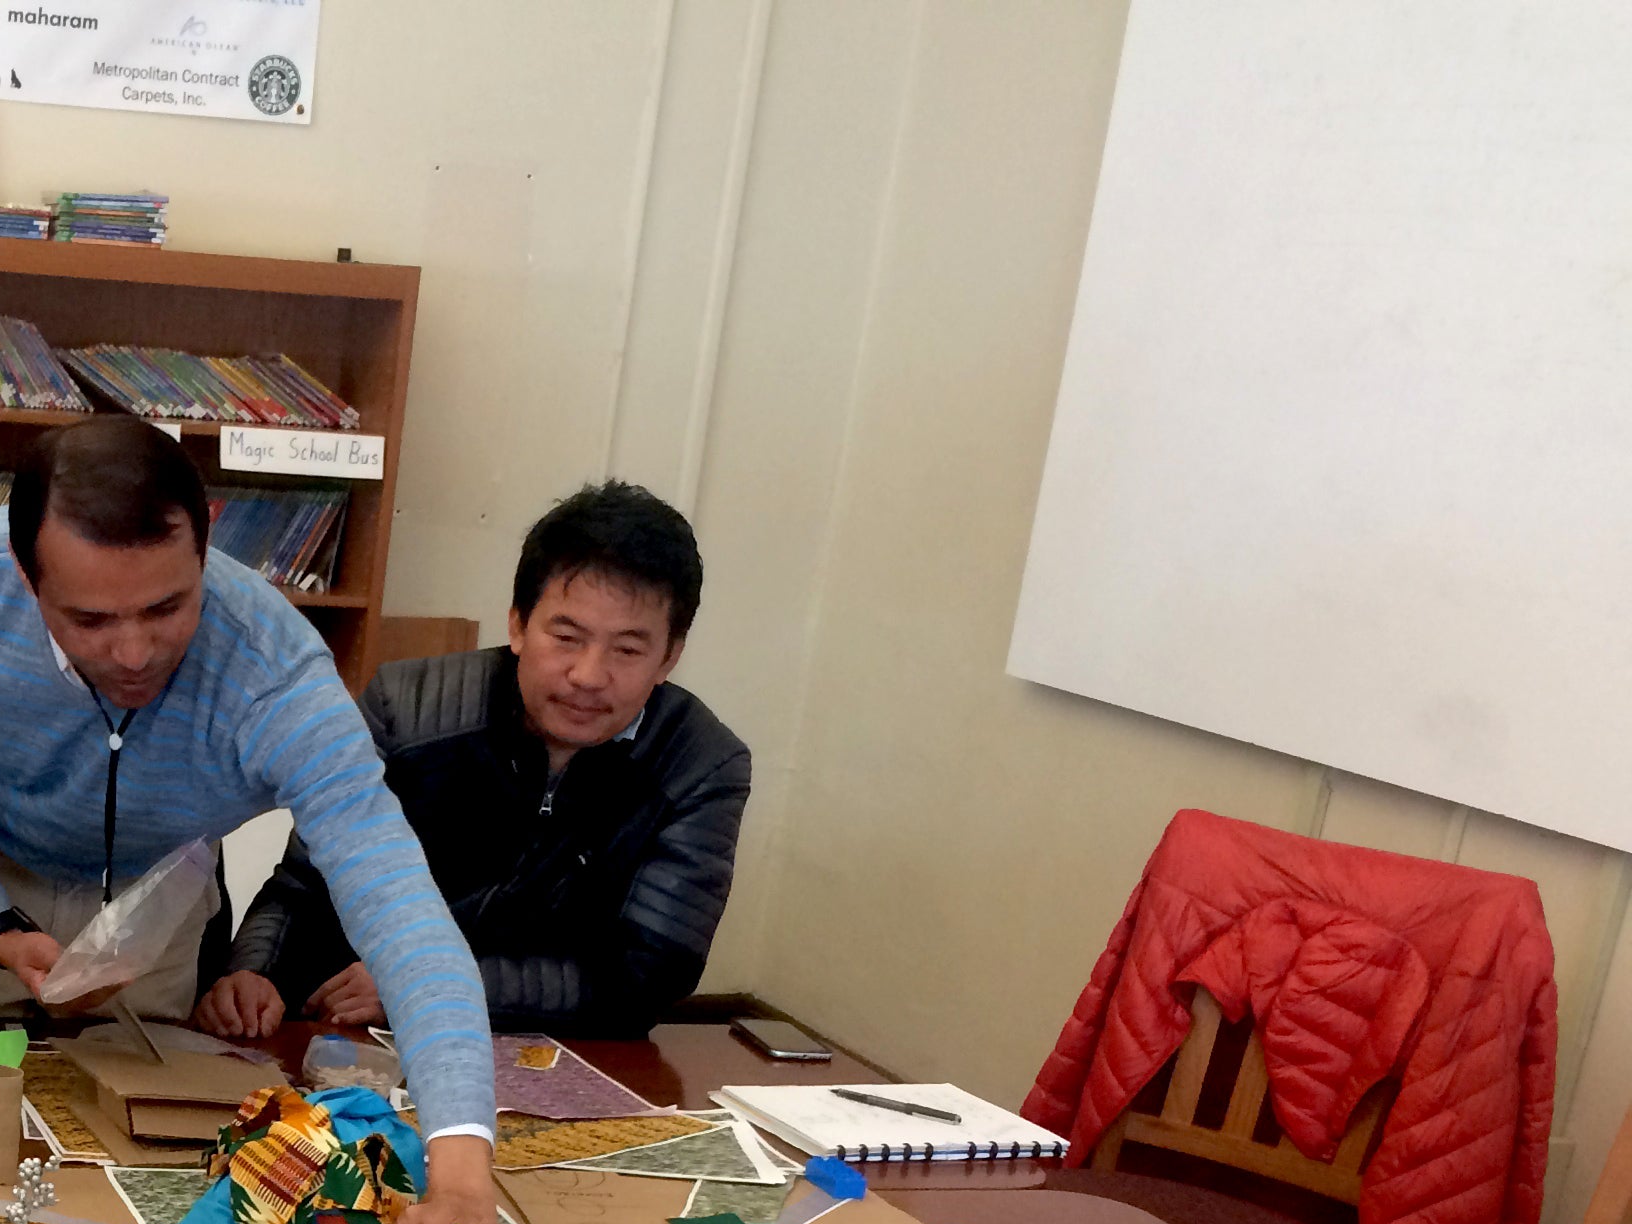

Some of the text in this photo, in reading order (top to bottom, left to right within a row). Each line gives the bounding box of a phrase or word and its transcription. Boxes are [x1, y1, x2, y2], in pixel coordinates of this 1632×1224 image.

[8, 7, 99, 30] maharam
[93, 62, 240, 87] Metropolitan Contract
[252, 58, 298, 85] STARBUCKS
[121, 86, 207, 106] Carpets, Inc.
[255, 96, 290, 112] COFFEE
[229, 431, 379, 466] Magic School Bus
